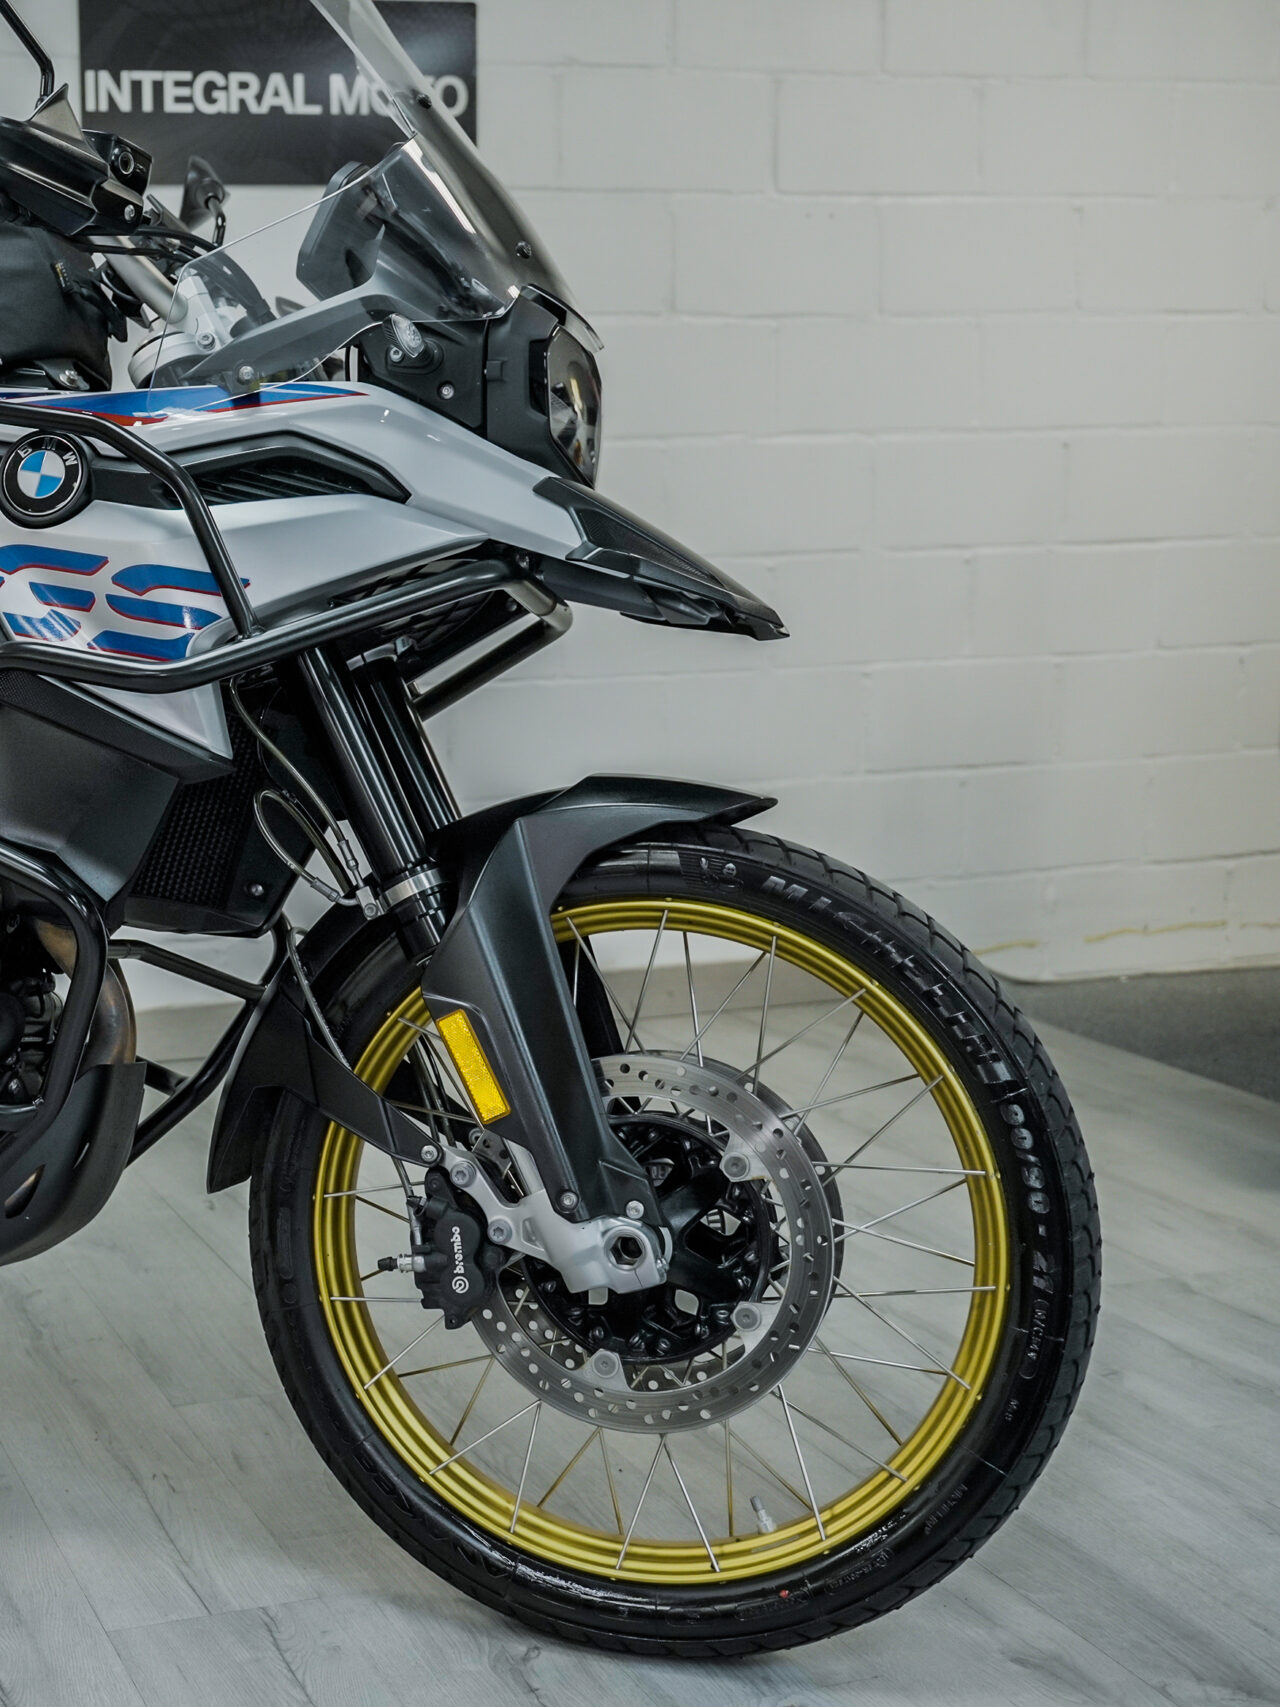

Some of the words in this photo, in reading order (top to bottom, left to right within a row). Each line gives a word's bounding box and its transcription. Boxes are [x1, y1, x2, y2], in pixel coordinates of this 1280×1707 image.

[84, 69, 323, 116] INTEGRAL
[18, 437, 79, 467] BMW
[450, 1226, 465, 1274] brembo
